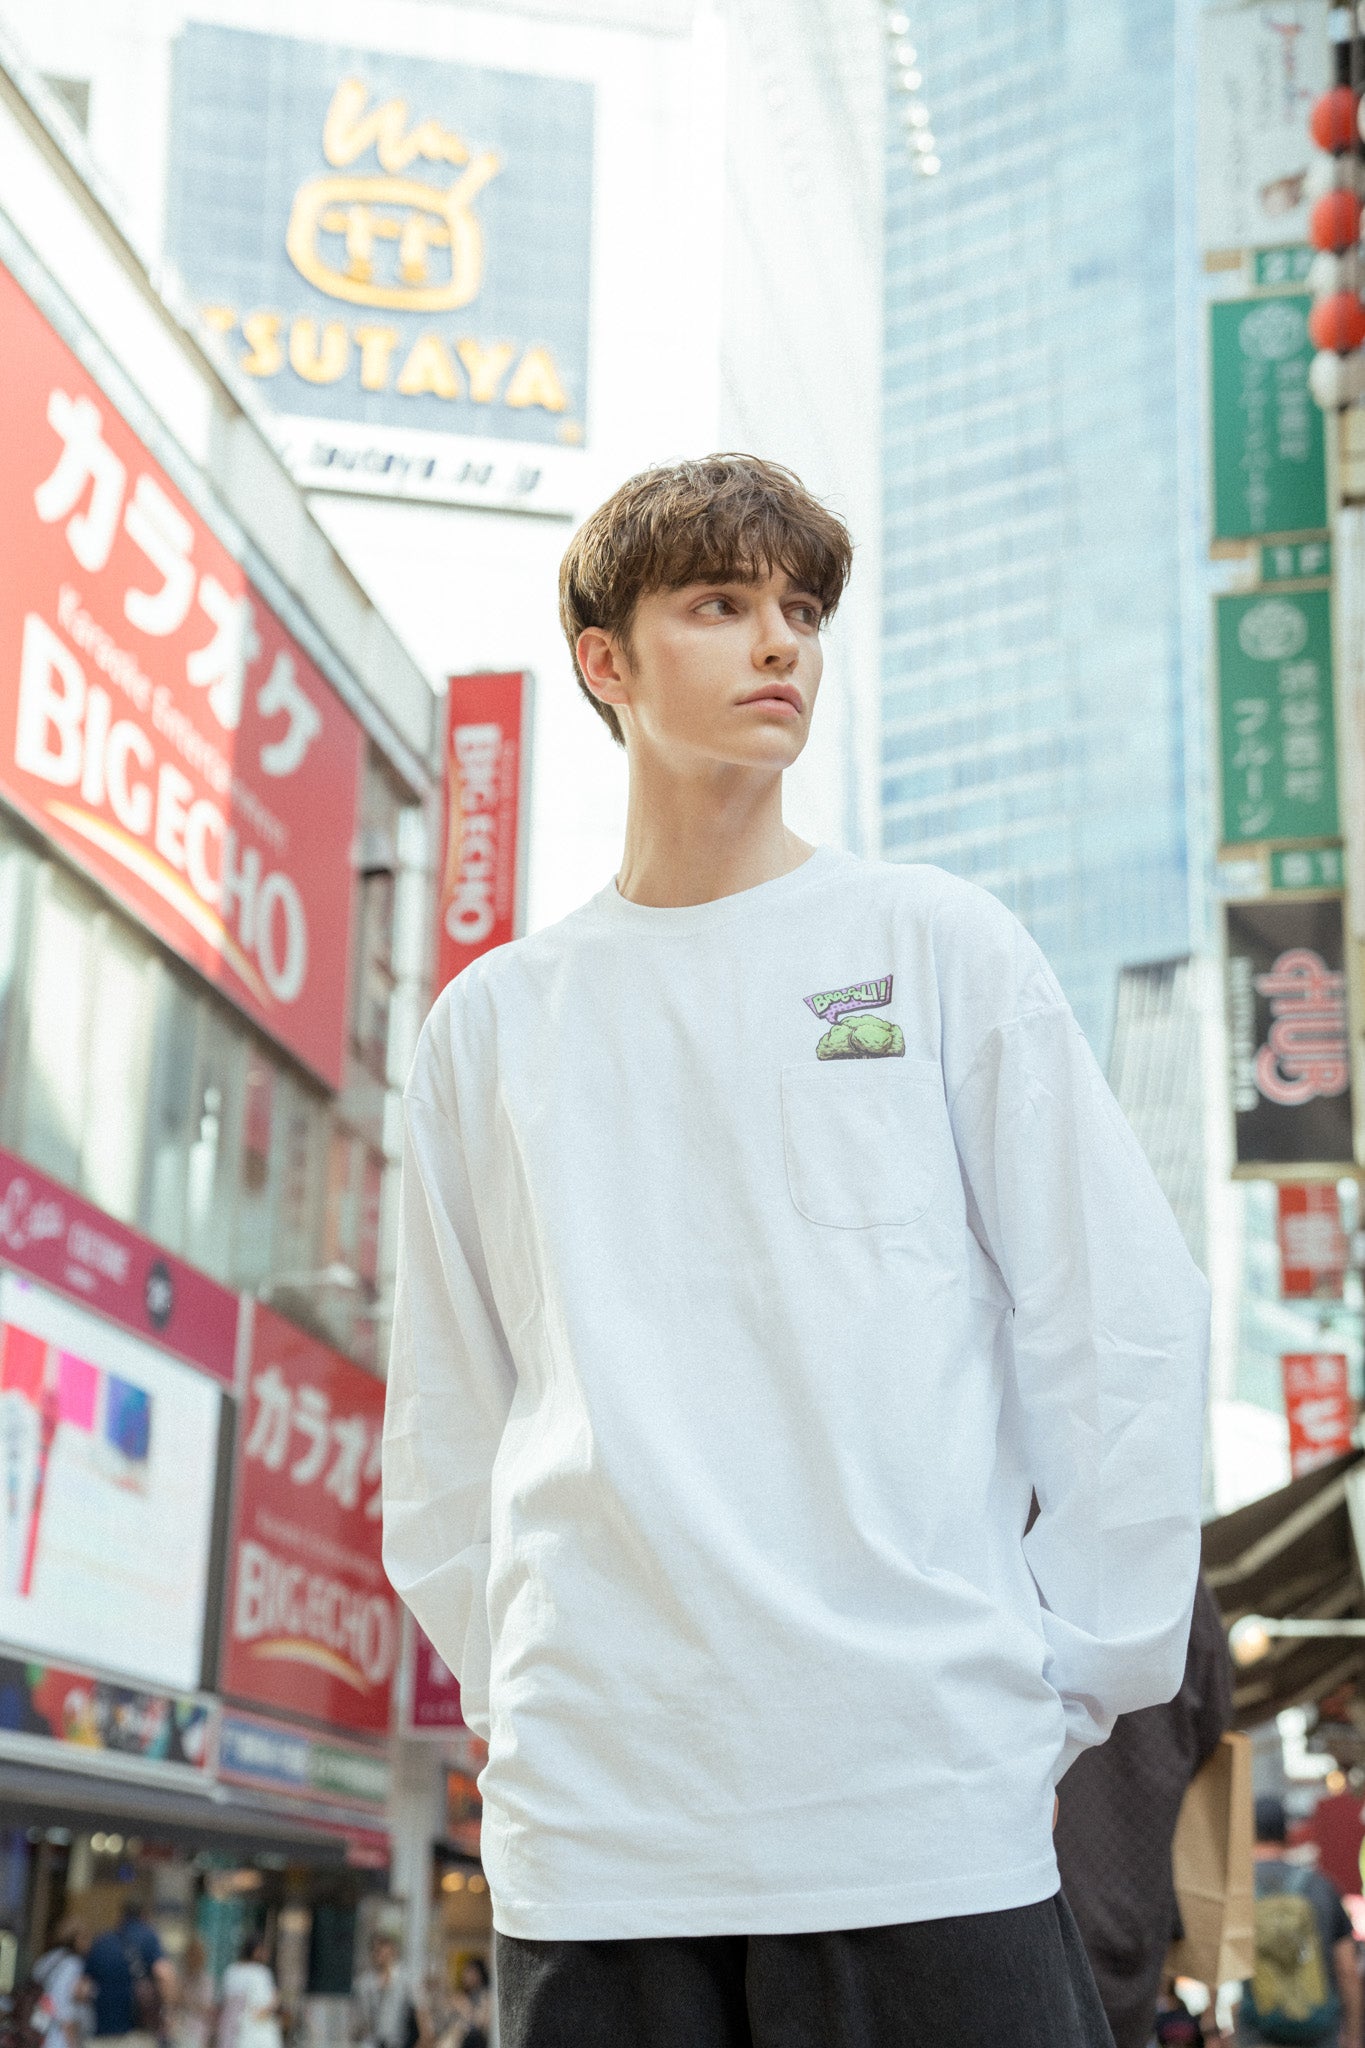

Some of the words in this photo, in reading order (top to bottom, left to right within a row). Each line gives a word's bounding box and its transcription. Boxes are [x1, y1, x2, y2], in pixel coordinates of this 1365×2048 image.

[33, 388, 322, 778] カラオケ
[1254, 948, 1350, 1106] HUB
